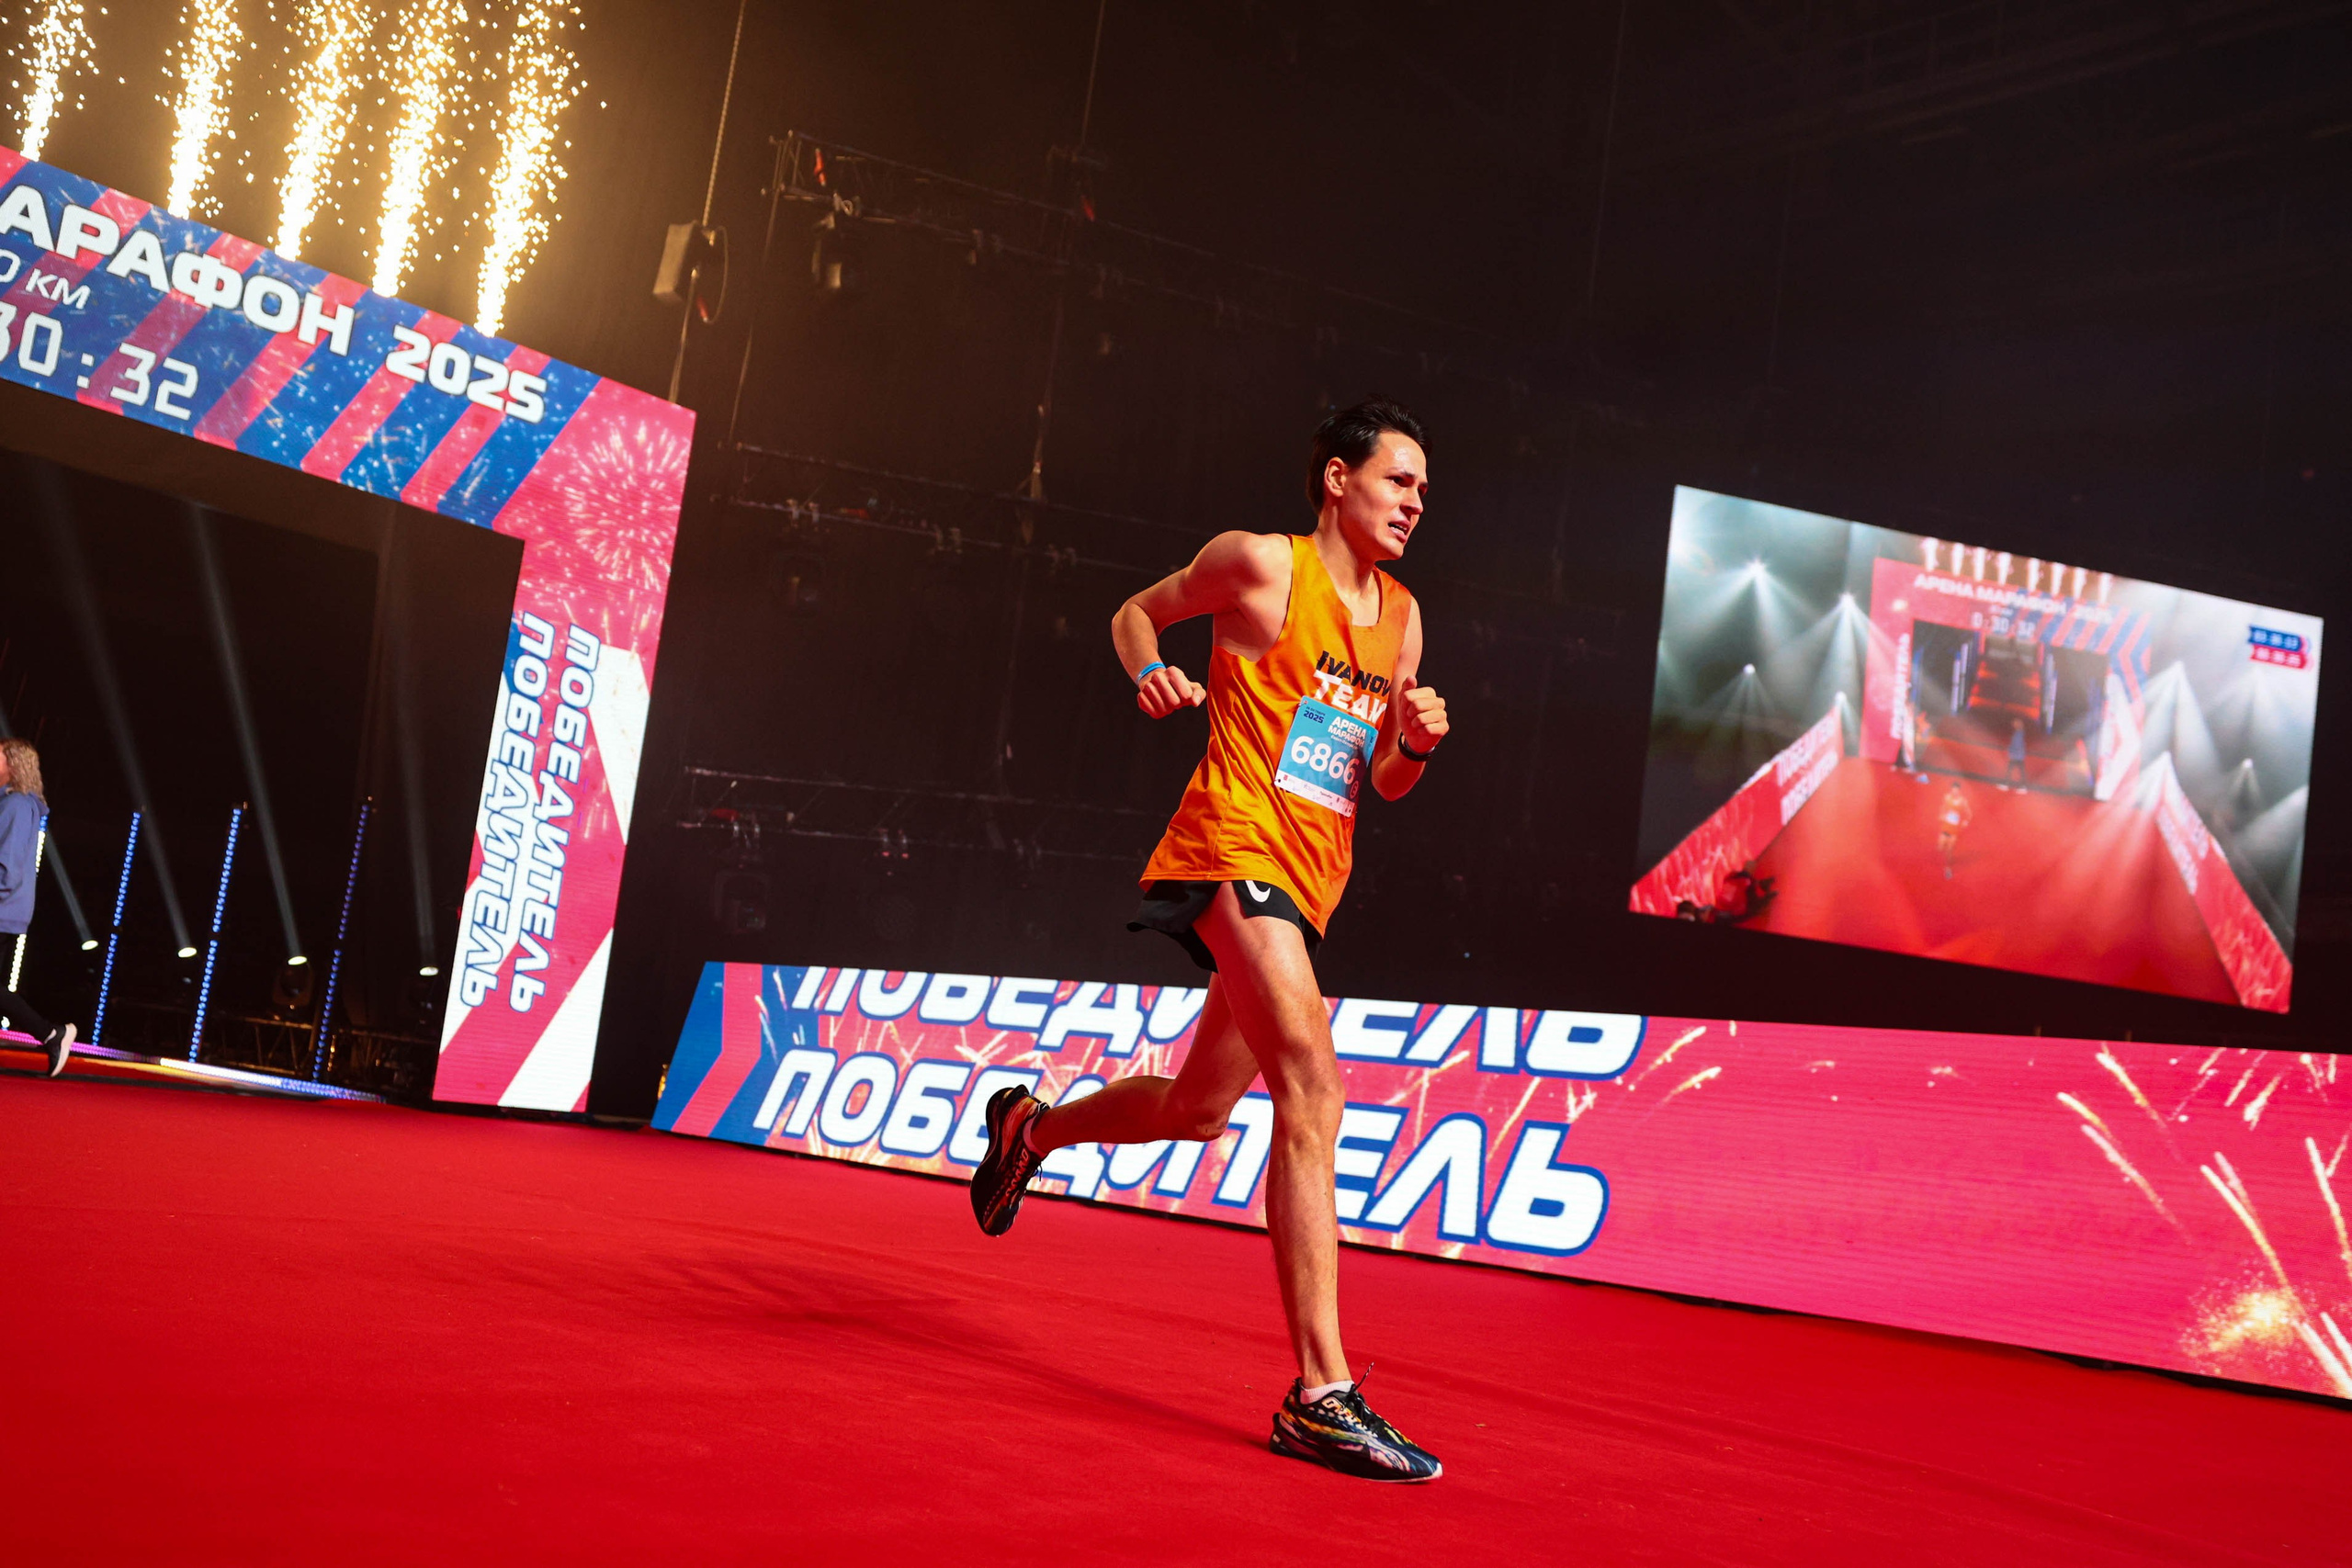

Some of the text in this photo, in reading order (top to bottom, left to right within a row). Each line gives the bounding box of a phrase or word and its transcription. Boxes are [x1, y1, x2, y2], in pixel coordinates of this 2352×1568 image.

[386, 324, 548, 423] 2025
[1303, 709, 1325, 725] 2025
[1328, 725, 1365, 748] МАРАФОН
[1331, 716, 1367, 739] АРЕНА
[1291, 735, 1360, 785] 6866
[458, 609, 556, 1009] ПОБЕДИТЕЛЬ
[508, 622, 602, 1013] ПОБЕДИТЕЛЬ
